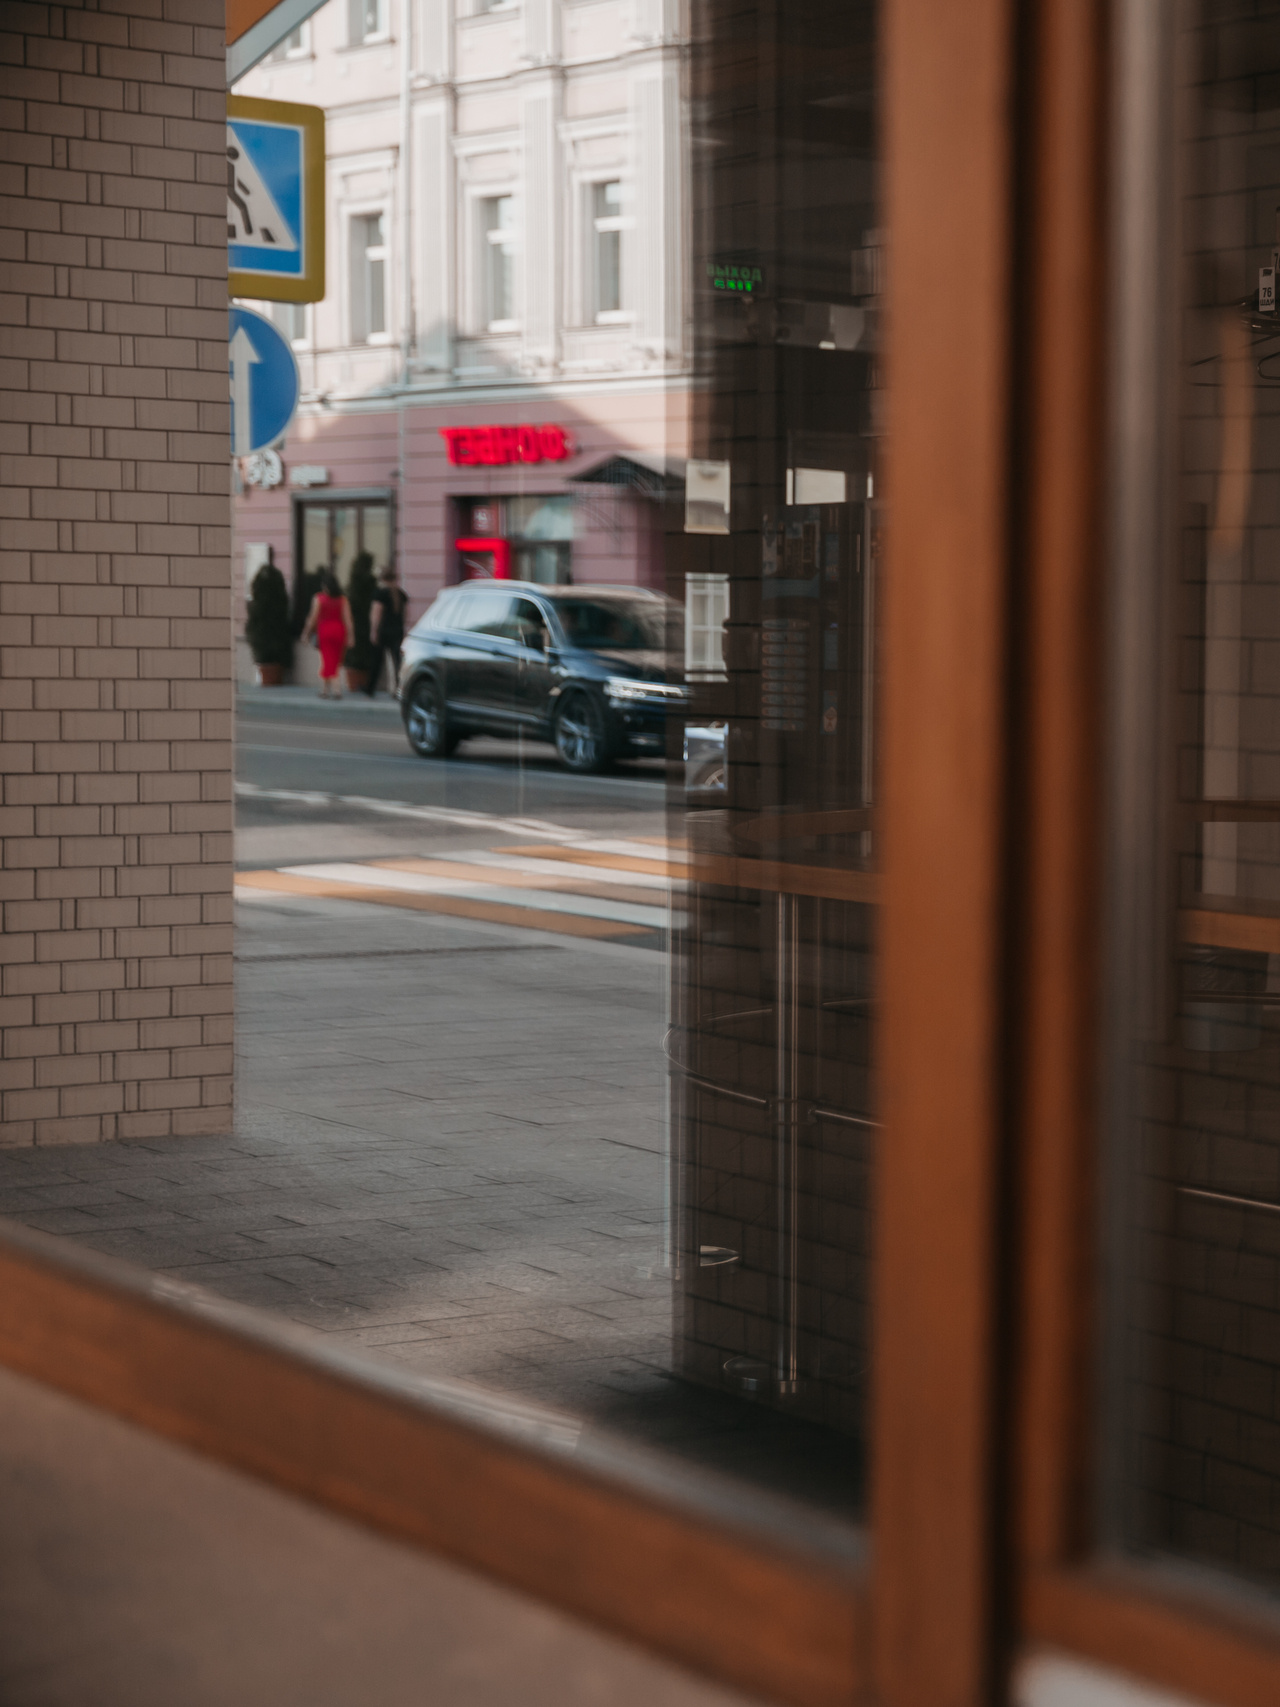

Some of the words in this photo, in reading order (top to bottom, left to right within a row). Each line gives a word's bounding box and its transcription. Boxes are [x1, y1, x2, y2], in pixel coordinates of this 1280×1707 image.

[706, 263, 762, 282] ВЫХОД
[714, 278, 753, 291] EXIT
[1262, 287, 1272, 298] 76
